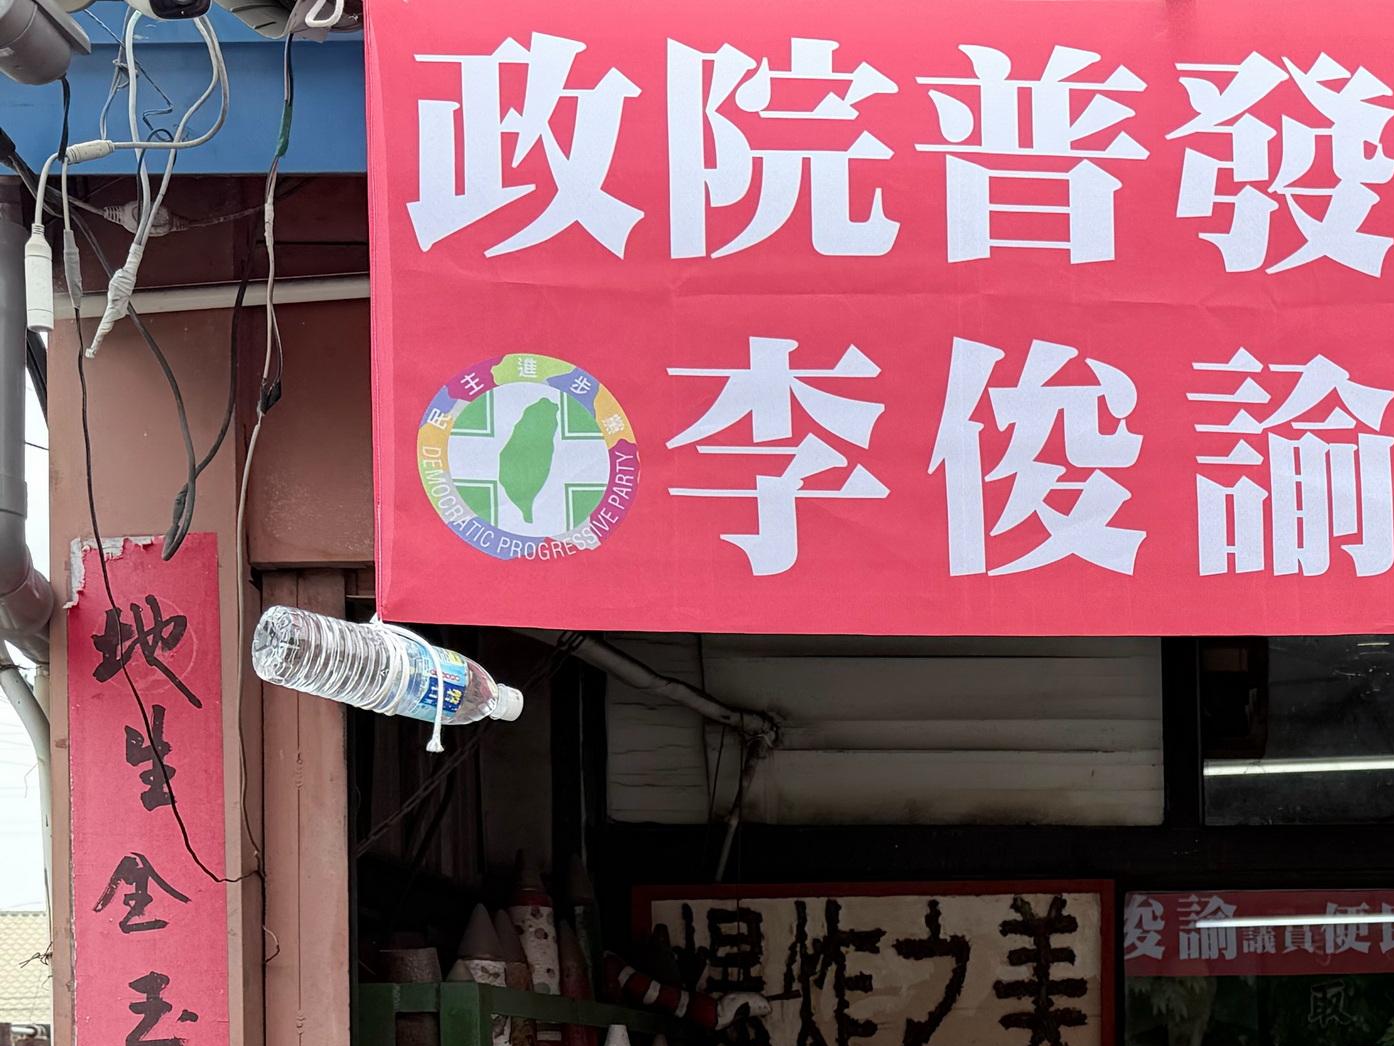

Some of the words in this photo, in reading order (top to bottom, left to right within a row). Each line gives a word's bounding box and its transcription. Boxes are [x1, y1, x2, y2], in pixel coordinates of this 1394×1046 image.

[422, 446, 496, 548] DEMOCRATIC
[497, 510, 619, 560] PROGRESSIVE
[608, 451, 635, 510] PARTY
